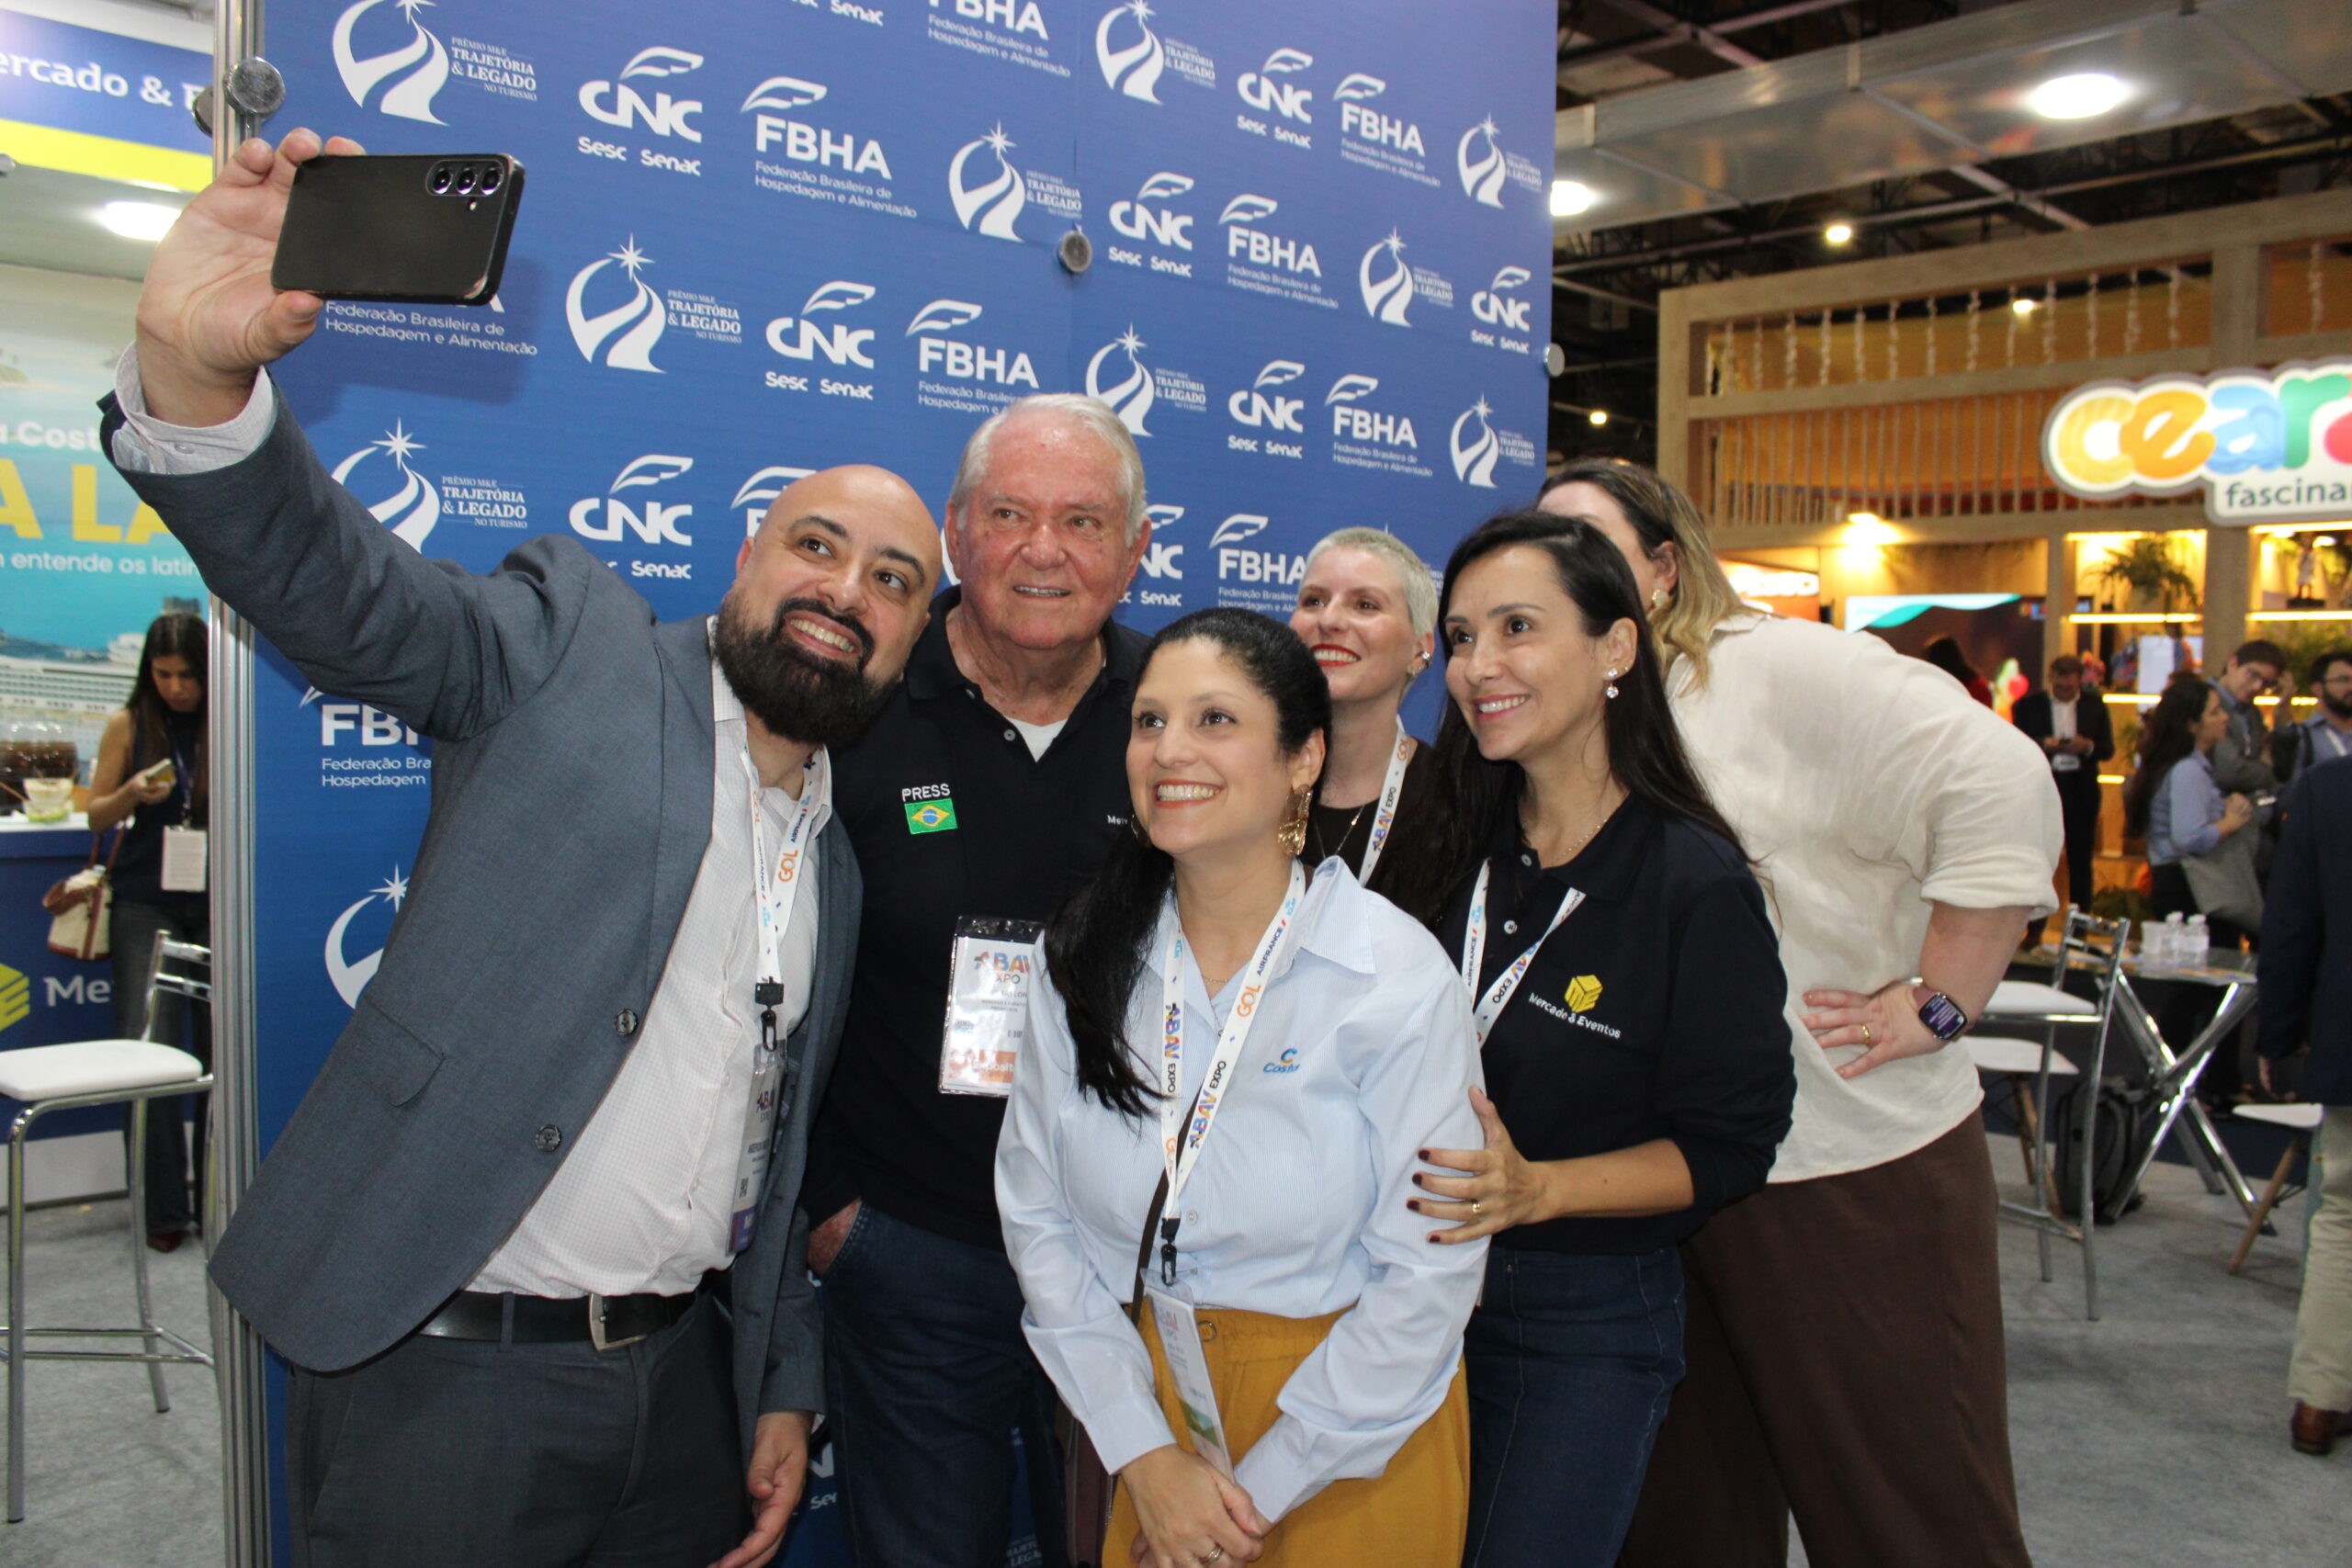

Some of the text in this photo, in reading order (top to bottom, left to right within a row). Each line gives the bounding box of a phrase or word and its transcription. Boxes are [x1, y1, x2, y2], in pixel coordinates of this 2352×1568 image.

[928, 0, 1049, 39] BHA
[451, 46, 536, 75] TRAJETÓRIA
[140, 74, 174, 107] &
[451, 61, 537, 92] & LEGADO
[579, 80, 703, 143] CNC
[1238, 73, 1312, 124] CNC
[1237, 114, 1311, 150] Sesc Senac
[1341, 102, 1425, 157] FBHA
[578, 136, 701, 176] Sesc Senac
[756, 114, 892, 180] FBHA
[755, 160, 892, 199] Federação Brasileira de
[755, 175, 917, 219] Hospedagem e Alimentação
[1036, 190, 1082, 211] LEGADO
[1109, 200, 1193, 251] CNC
[1108, 246, 1192, 277] Sesc Senac
[1228, 225, 1322, 277] FBHA
[325, 301, 504, 336] Federação Brasileira de
[667, 310, 741, 334] & LEGADO
[668, 299, 740, 320] TRAJETÓRIA
[1471, 291, 1531, 332] CNC
[325, 318, 537, 356] Hospedagem e Alimentação
[765, 317, 875, 369] CNC
[920, 336, 1039, 389] FBHA
[764, 371, 874, 400] Sesc Senac
[919, 380, 973, 399] Federação
[1164, 387, 1206, 404] LEGADO
[919, 394, 989, 413] Hospedagem
[1228, 390, 1304, 434] CNC
[17, 421, 100, 451] Cost
[1334, 405, 1418, 448] FBHA
[1227, 434, 1303, 459] Sesc Senac
[442, 475, 498, 488] PRÊMIO M&E
[442, 486, 525, 503] TRAJETÓRIA
[2225, 478, 2352, 508] fascina
[442, 501, 527, 520] & LEGADO
[474, 517, 528, 529] NO TURISMO
[569, 497, 693, 547] CNC
[11, 553, 113, 573] entende
[119, 558, 146, 574] os
[631, 559, 692, 580] Senac
[1218, 547, 1307, 585] FBHA
[1140, 590, 1182, 606] Senac
[1218, 586, 1261, 601] Federação
[322, 757, 401, 771] Federação
[322, 774, 426, 788] Hospedagem
[901, 783, 951, 803] PRESS
[778, 849, 798, 883] GOL
[1257, 927, 1283, 976] AIRFRANCE
[995, 973, 1021, 985] XPO
[1492, 977, 1513, 1004] EXPO
[1237, 984, 1261, 1017] GOL
[1529, 992, 1568, 1021] Mercado
[1577, 1015, 1622, 1040] Eventos
[1167, 1063, 1176, 1093] EXPO
[1209, 1060, 1227, 1089] EXPO
